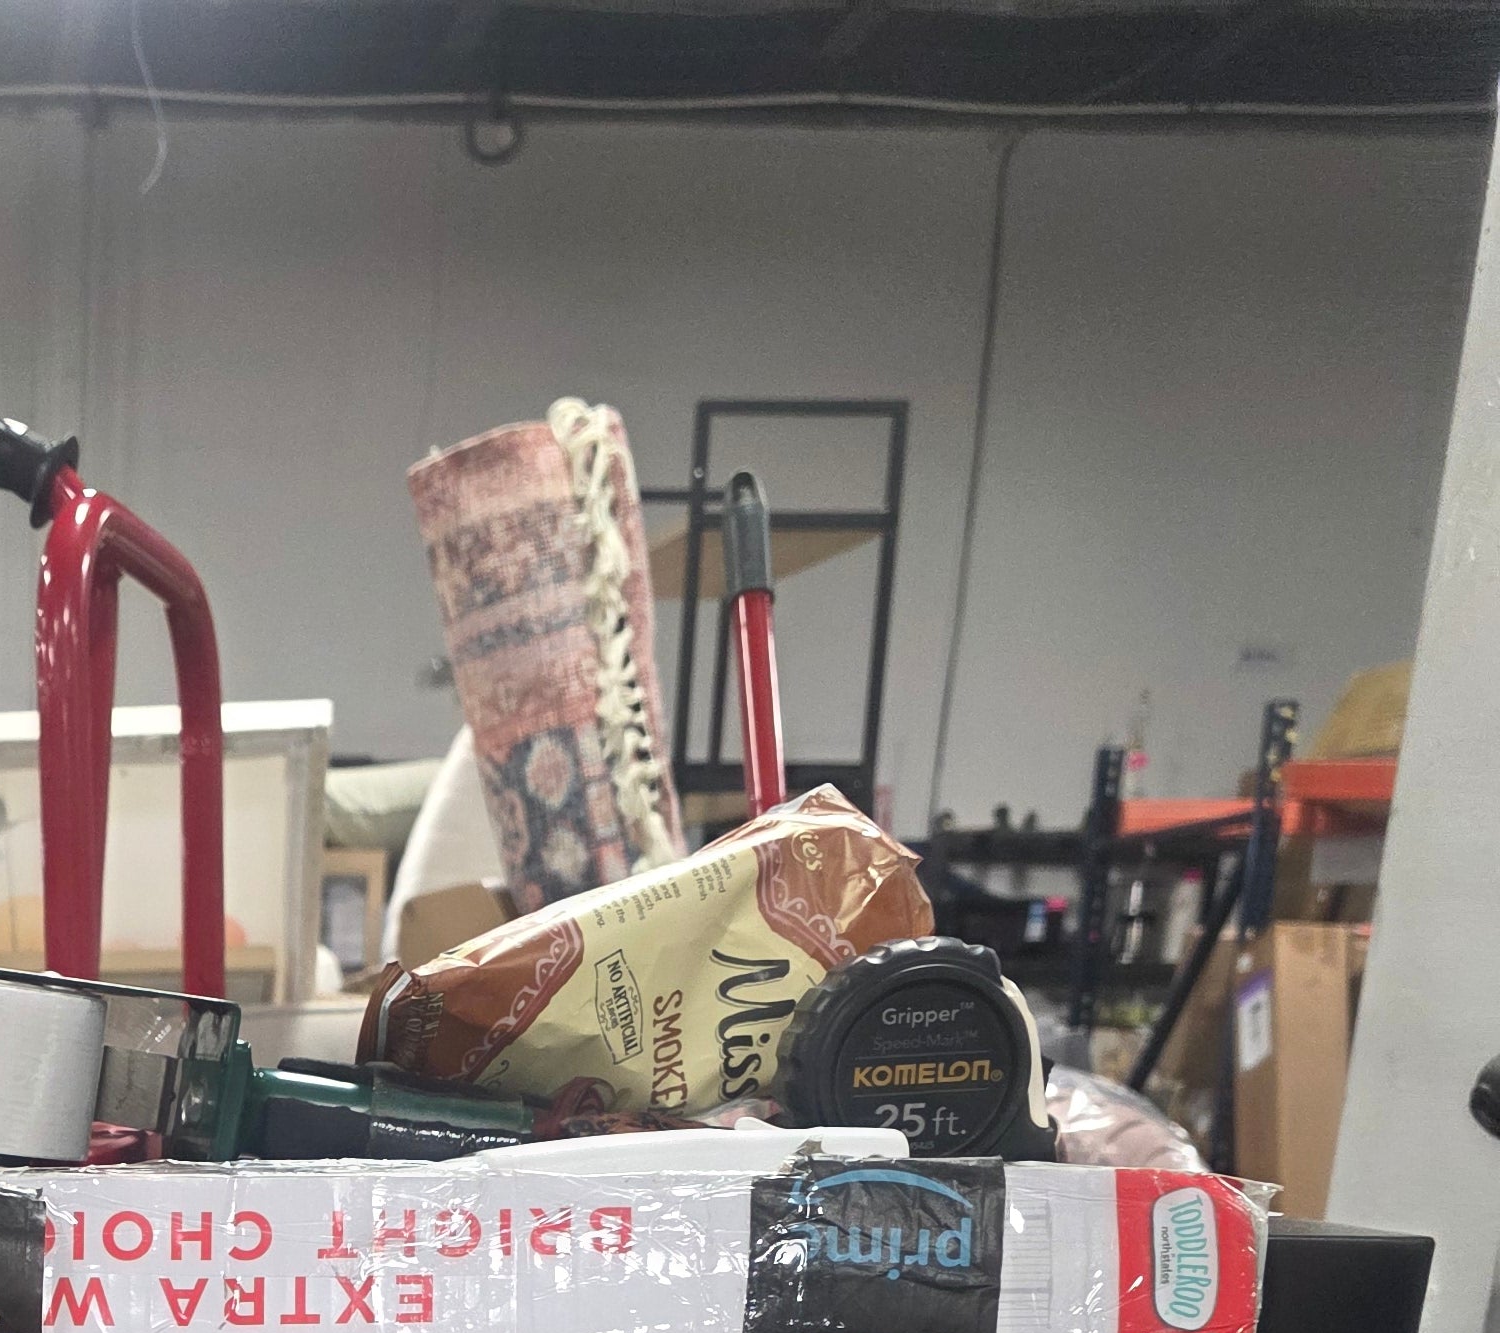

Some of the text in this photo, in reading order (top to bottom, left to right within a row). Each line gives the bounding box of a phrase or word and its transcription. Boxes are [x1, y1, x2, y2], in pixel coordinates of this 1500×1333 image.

[607, 959, 642, 1056] NO ARTIFICIAL
[711, 948, 797, 1101] Miss
[874, 1102, 968, 1138] 25 ft.
[43, 1211, 272, 1261] CHOI
[317, 1206, 632, 1260] BRIGHT
[787, 1216, 973, 1281] prime
[1167, 1194, 1213, 1319] TODDLEROO
[159, 1274, 434, 1326] EXTRA
